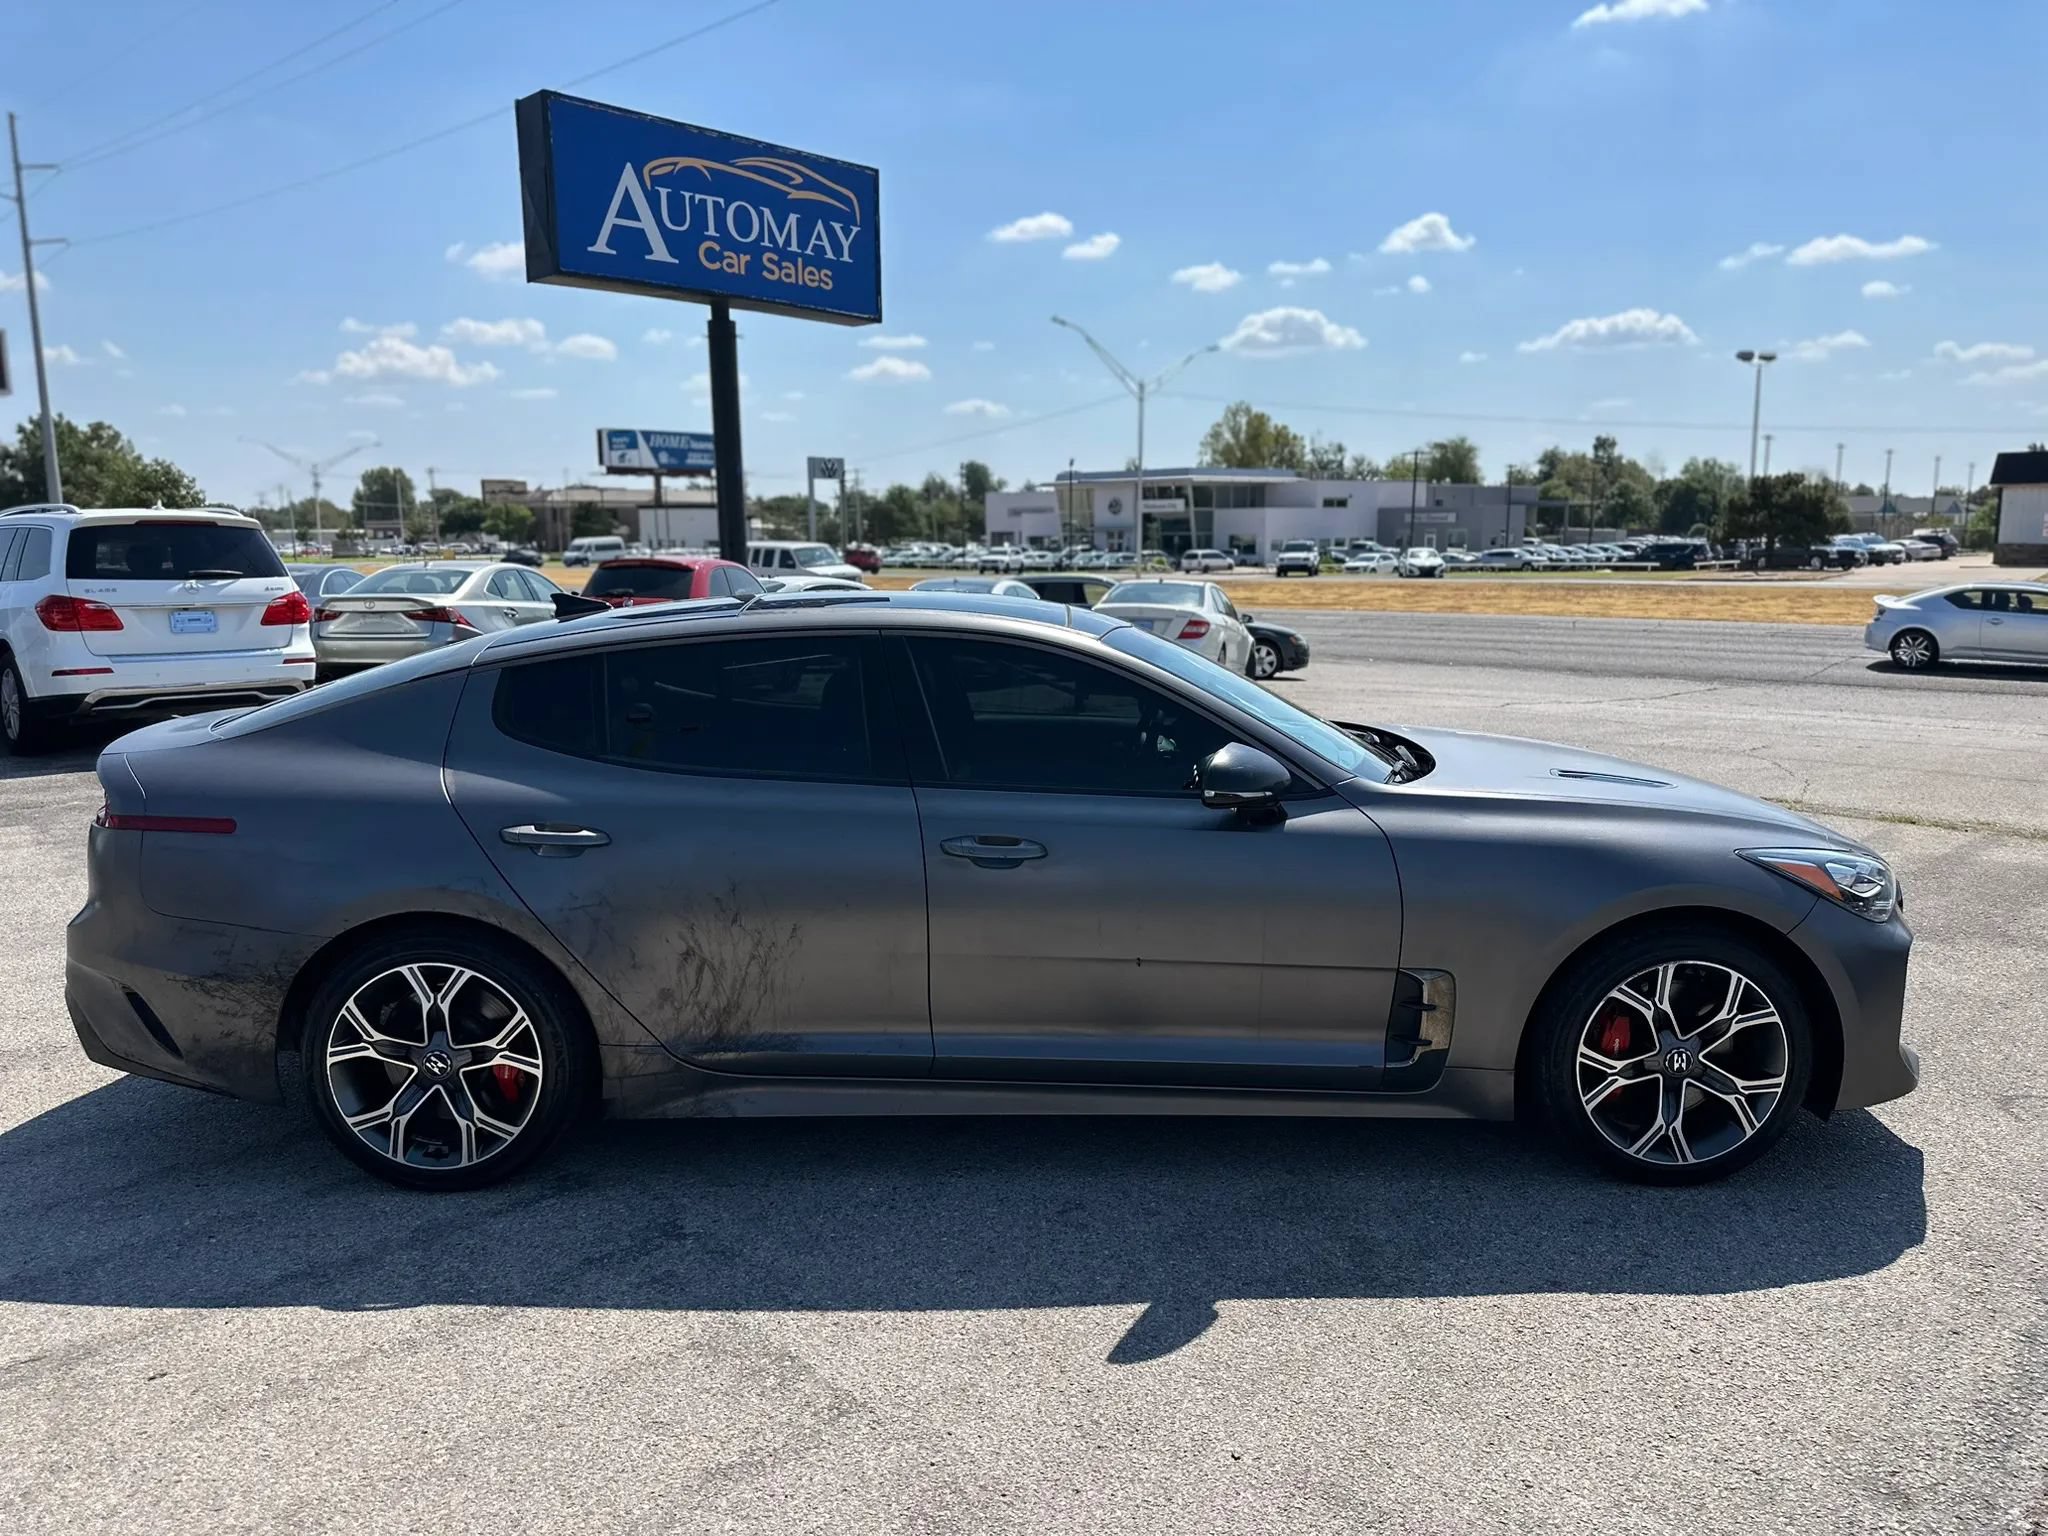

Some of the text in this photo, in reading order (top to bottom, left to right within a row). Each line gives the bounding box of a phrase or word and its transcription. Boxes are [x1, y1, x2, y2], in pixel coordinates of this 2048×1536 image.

[587, 162, 861, 264] AUTOMAY
[698, 241, 833, 291] Car Sales
[649, 433, 690, 449] HOME
